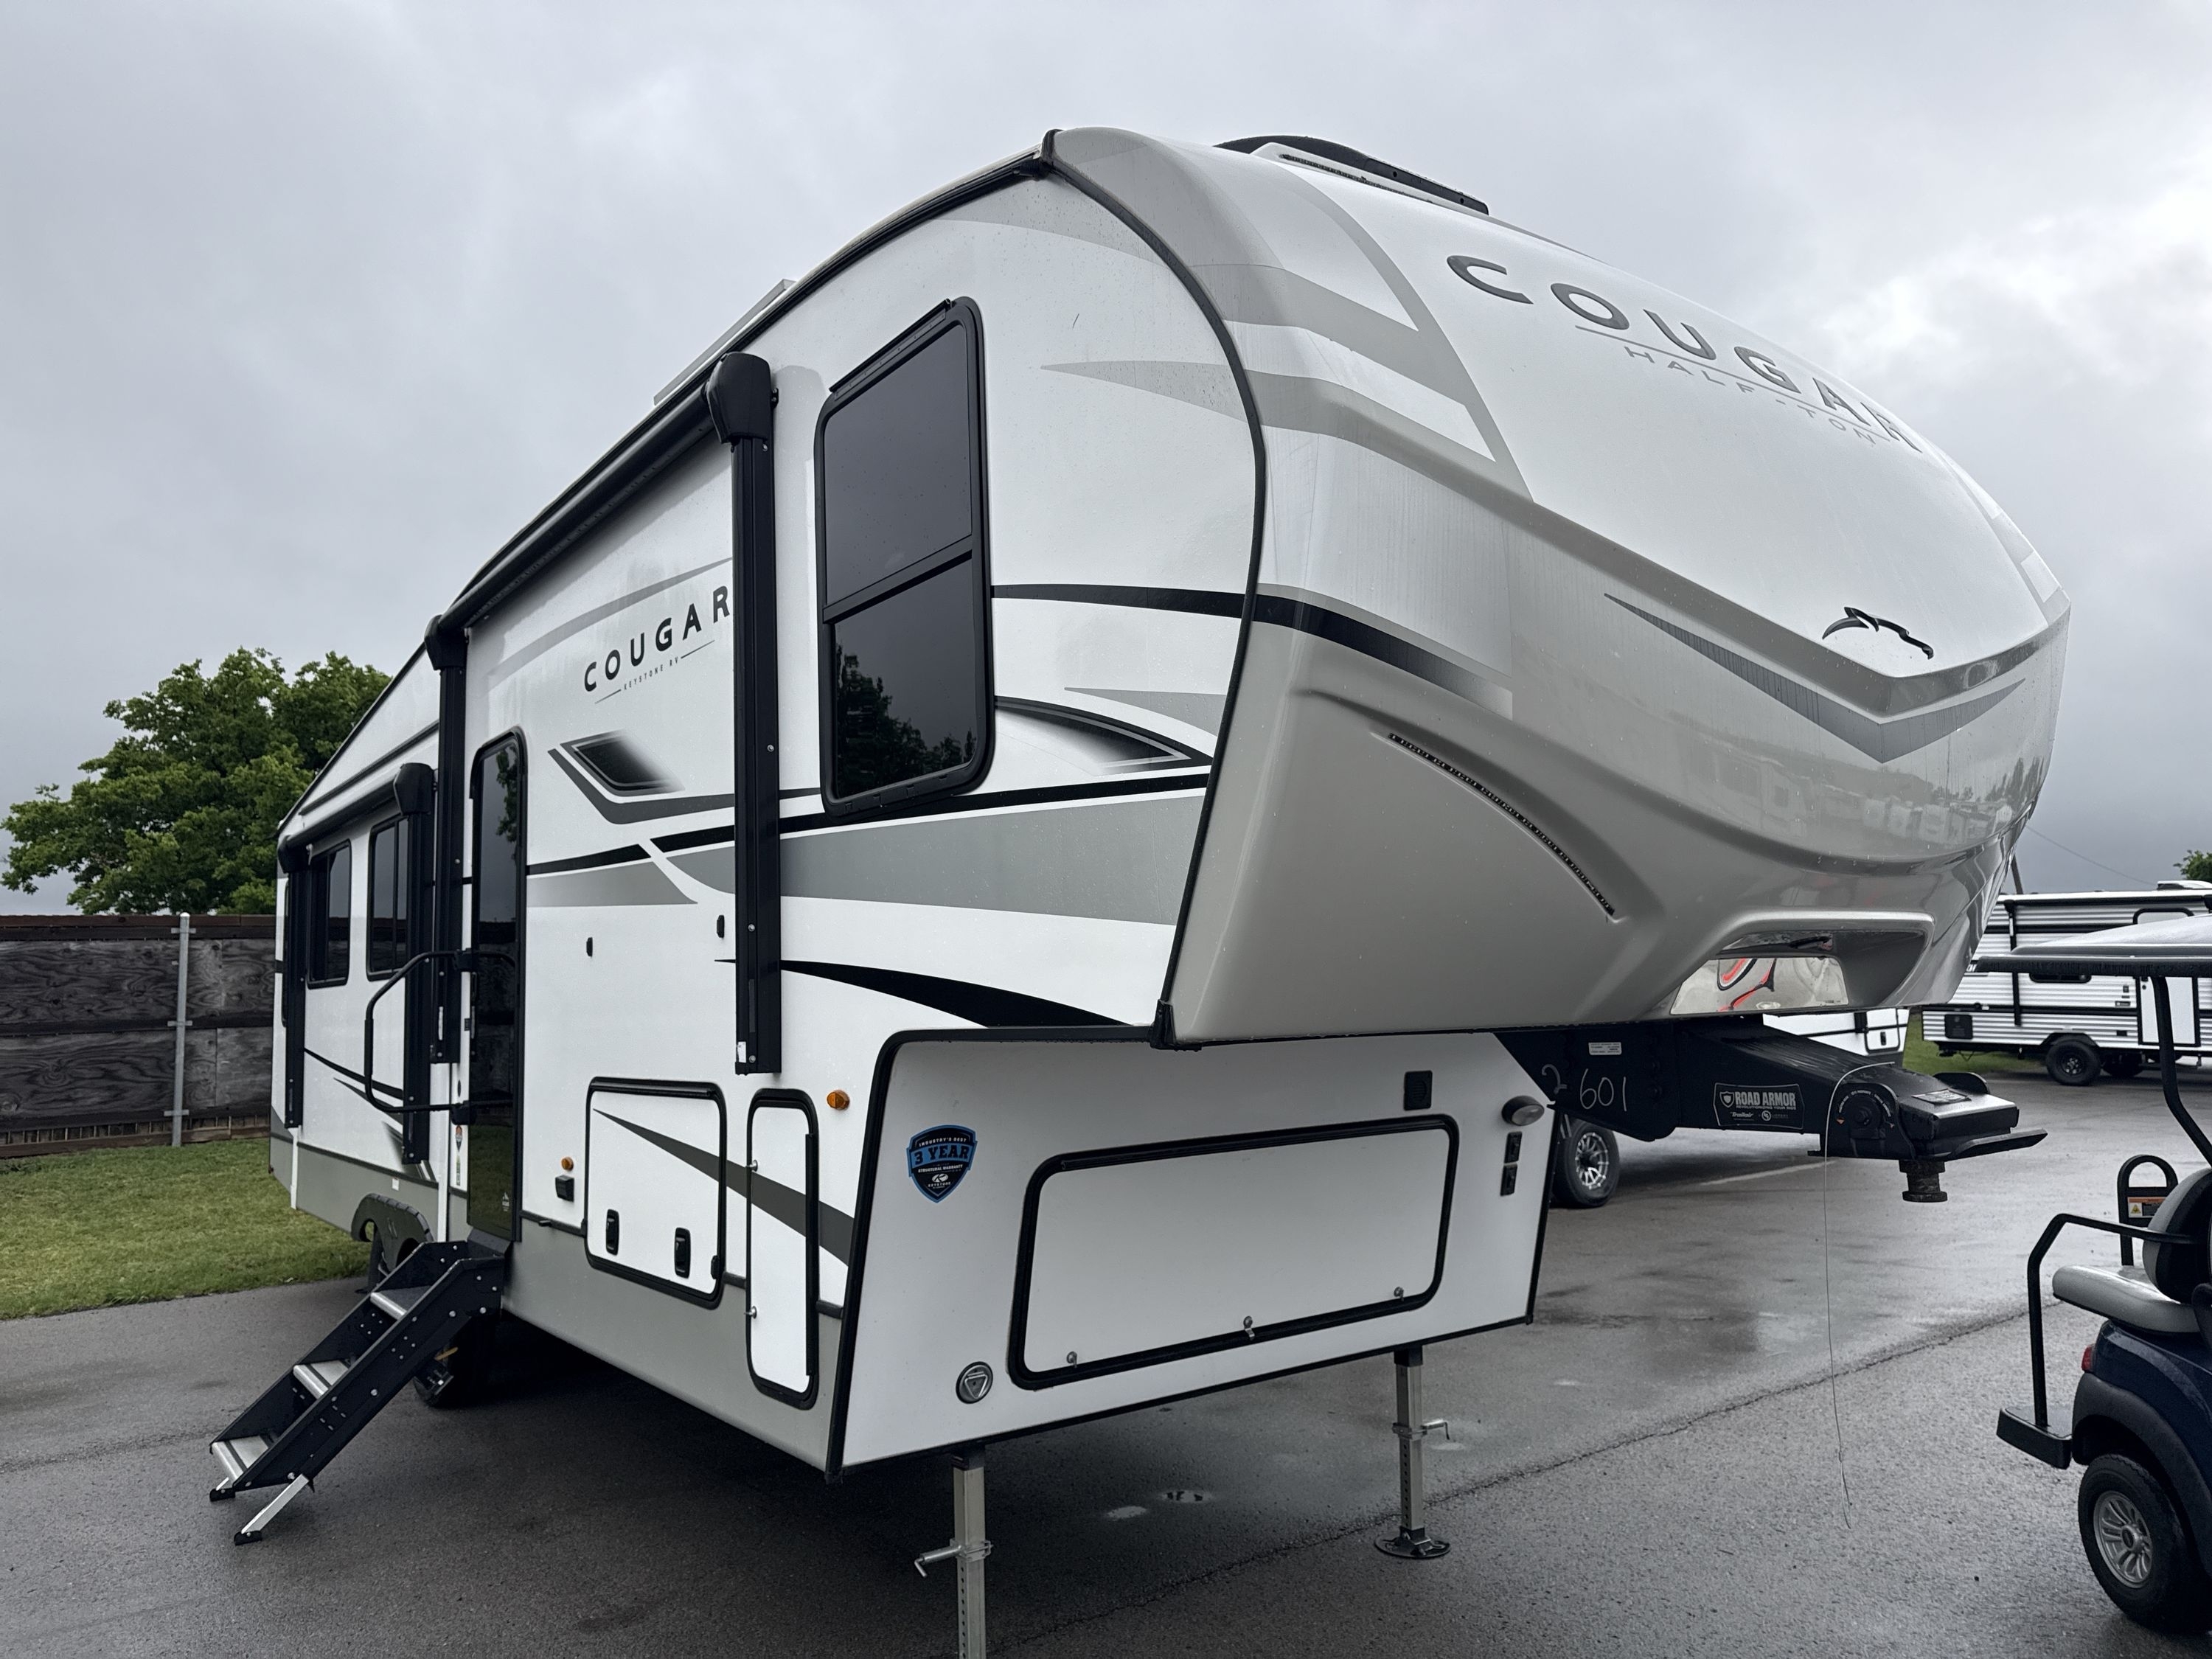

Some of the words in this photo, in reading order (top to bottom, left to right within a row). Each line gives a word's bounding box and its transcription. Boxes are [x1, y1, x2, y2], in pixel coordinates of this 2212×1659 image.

[1447, 255, 1923, 453] COUGAR
[584, 585, 730, 692] COUGAR
[624, 664, 663, 690] KEYSTONE
[669, 656, 678, 667] RV
[1735, 1091, 1761, 1106] ROAD
[1762, 1092, 1796, 1107] ARMOR
[914, 1151, 923, 1165] 3
[928, 1145, 970, 1161] YEAR
[919, 1137, 952, 1147] INDUSTRY'S
